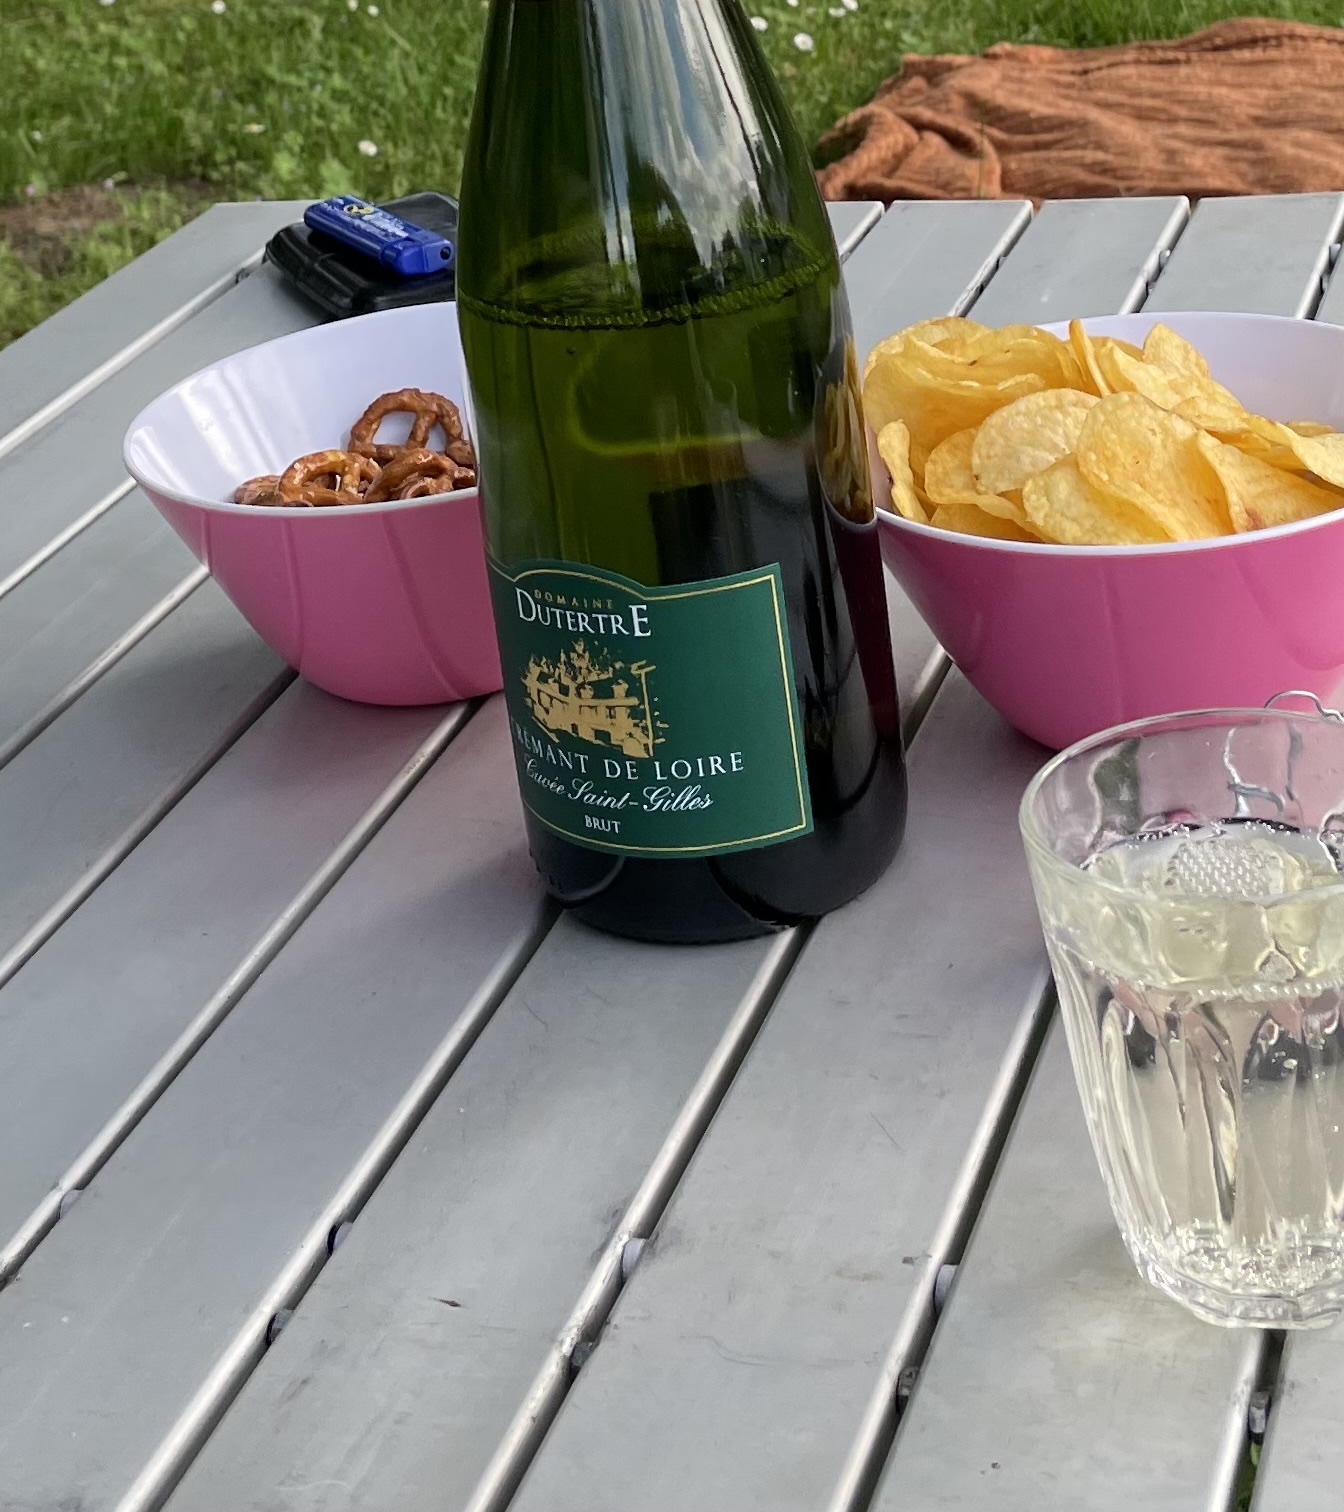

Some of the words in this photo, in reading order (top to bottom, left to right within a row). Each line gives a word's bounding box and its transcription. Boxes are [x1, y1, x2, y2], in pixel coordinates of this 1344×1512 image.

[515, 586, 652, 637] DUTERTRE
[534, 589, 614, 610] DOMAINE
[604, 759, 639, 780] DE
[654, 751, 745, 781] LOIRE
[567, 778, 714, 812] Saint-Gilles
[585, 814, 621, 834] BRUT
